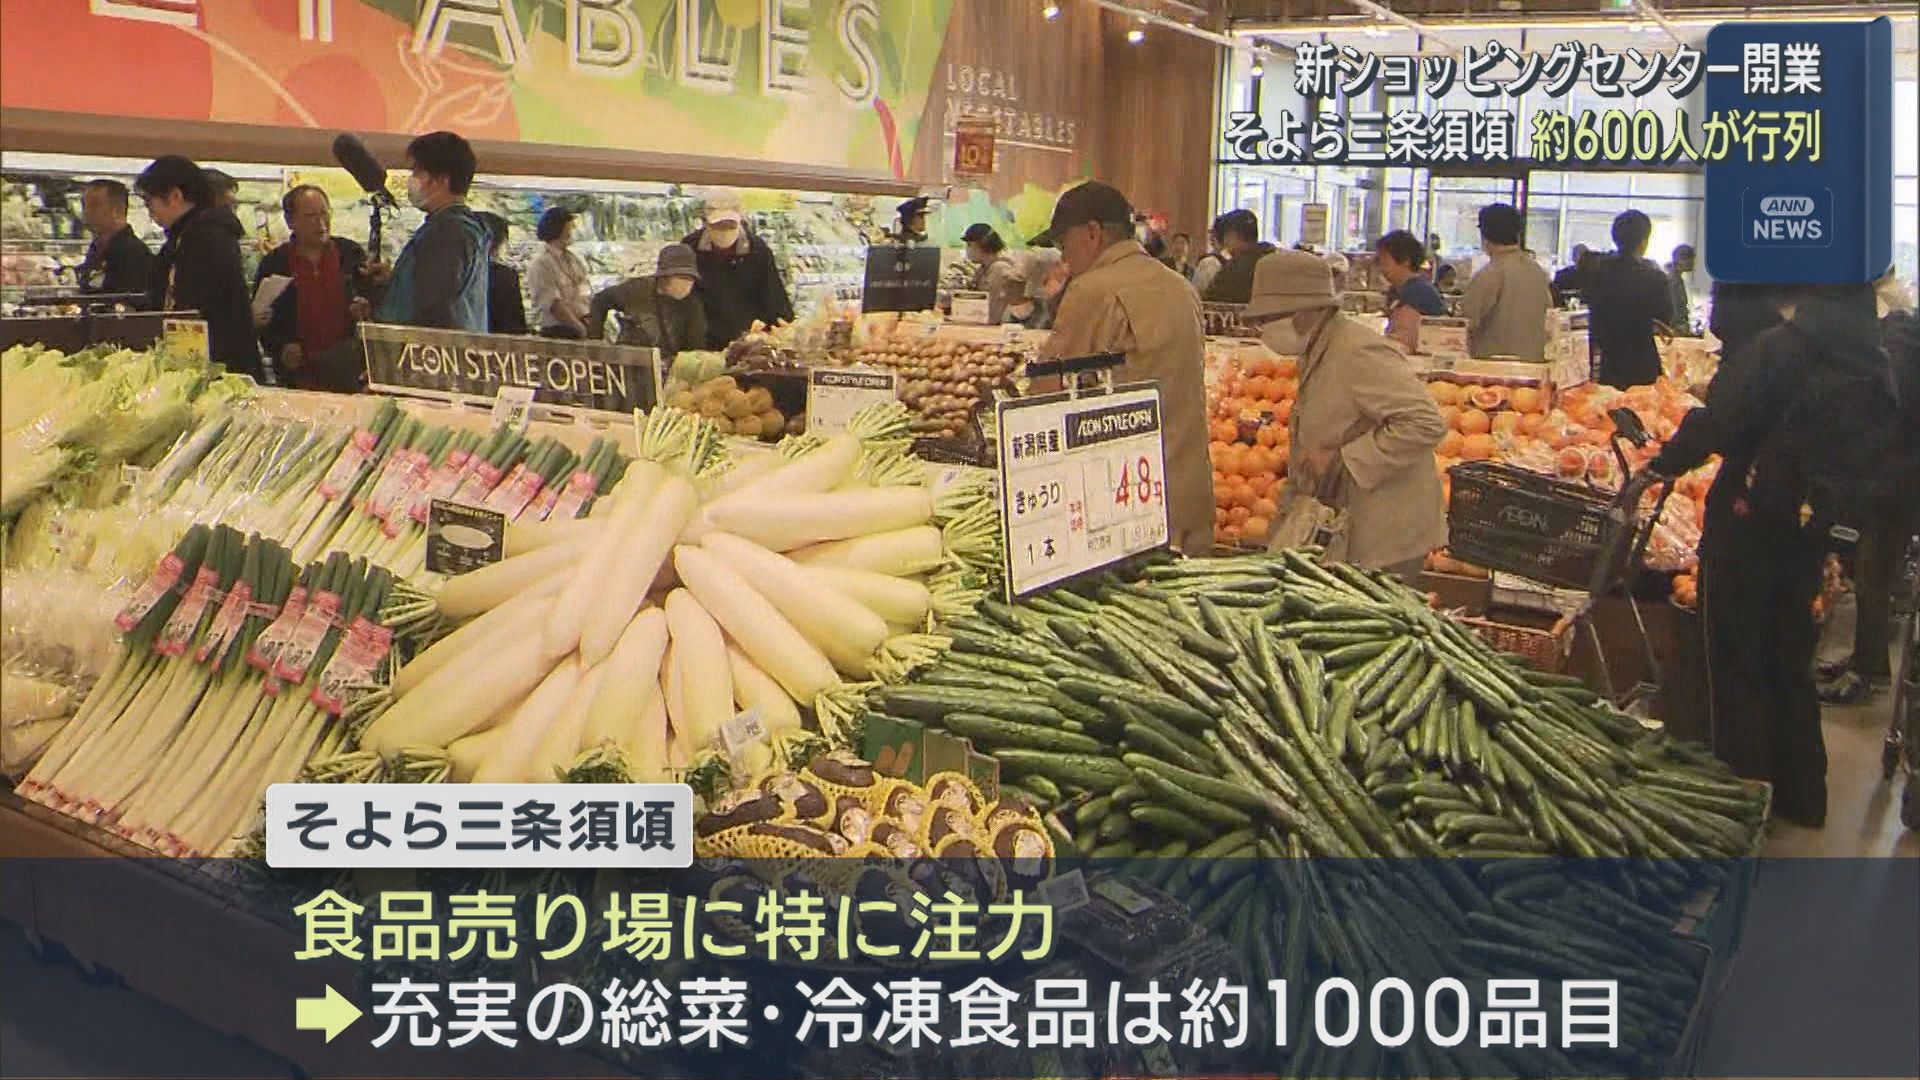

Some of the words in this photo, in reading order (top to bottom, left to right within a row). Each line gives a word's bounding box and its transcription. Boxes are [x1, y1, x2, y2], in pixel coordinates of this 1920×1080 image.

[464, 348, 541, 387] STYLE
[547, 356, 627, 398] OPEN
[1101, 413, 1129, 434] STYLE
[1129, 408, 1152, 428] OPEN
[1016, 481, 1061, 515] きゅうり
